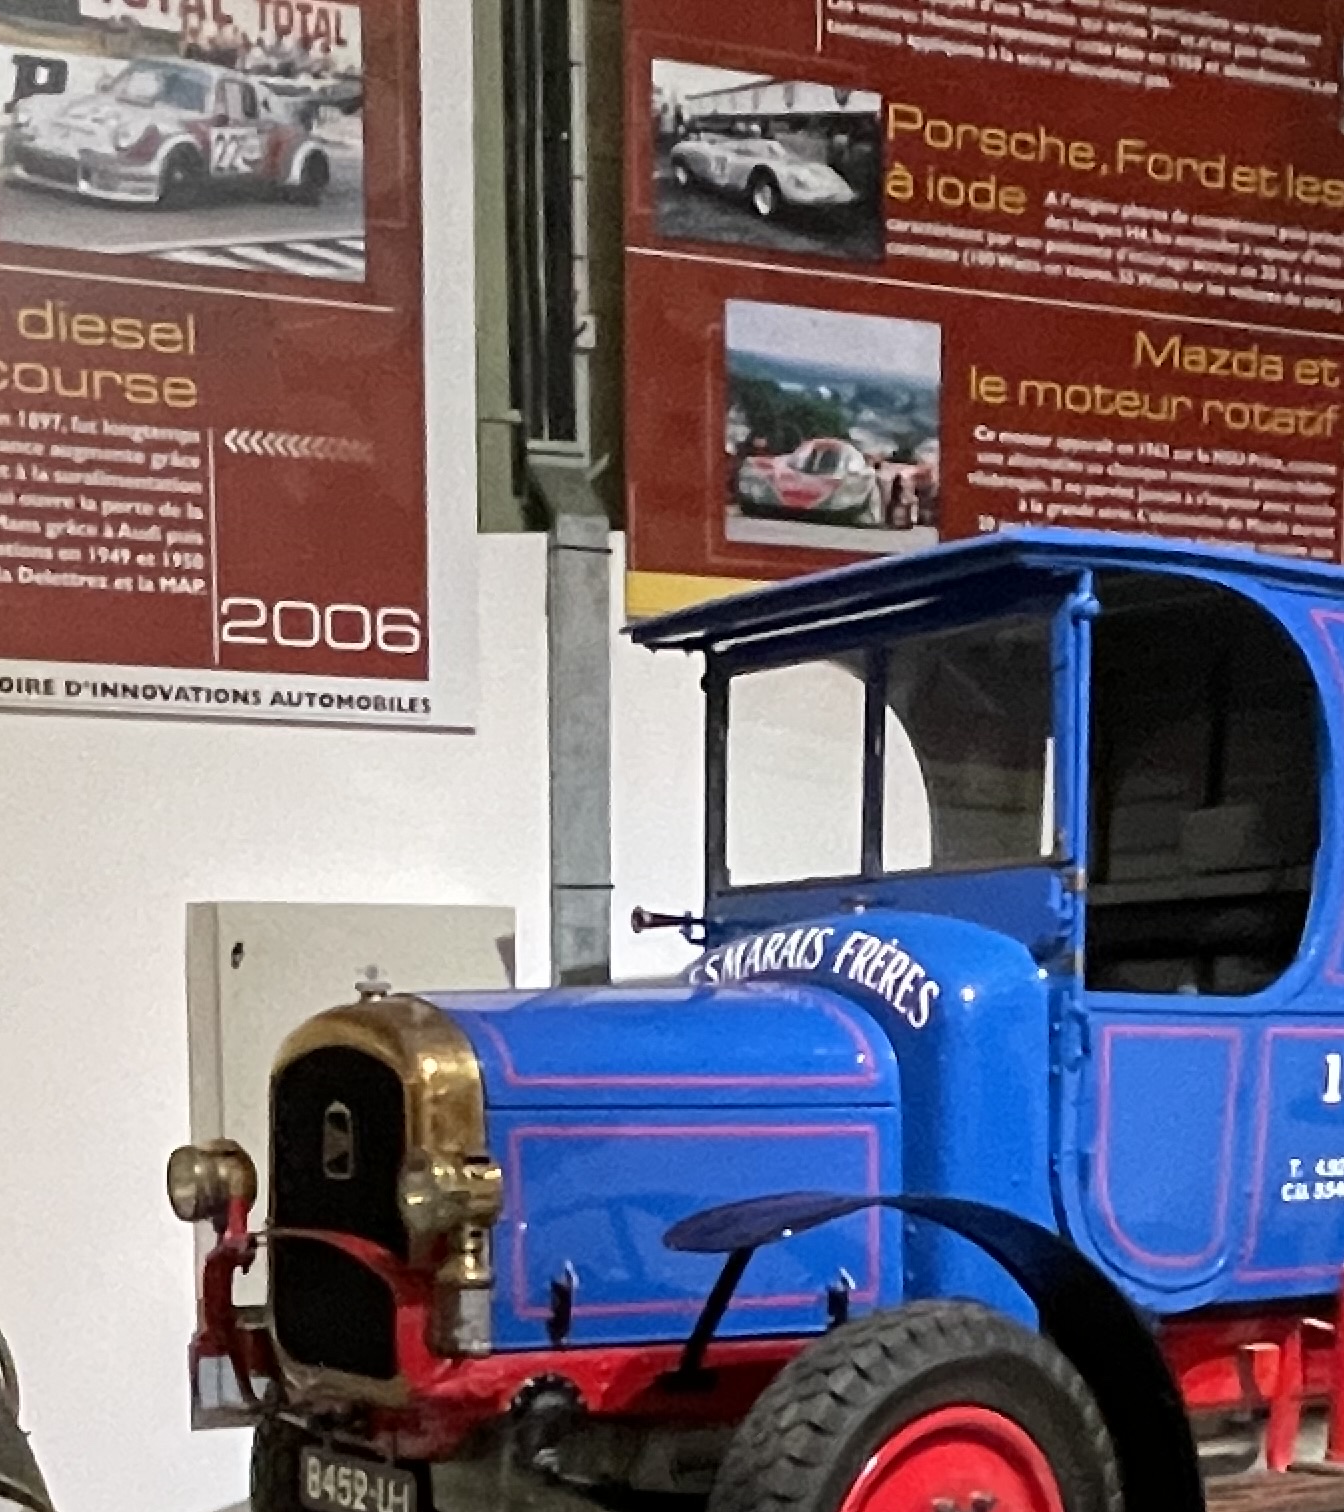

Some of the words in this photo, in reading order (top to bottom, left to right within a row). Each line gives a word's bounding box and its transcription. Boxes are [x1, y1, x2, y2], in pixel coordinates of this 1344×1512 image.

[887, 101, 1109, 177] Porsche,
[1116, 137, 1226, 190] Ford
[1231, 166, 1279, 198] et
[885, 161, 915, 201] à
[926, 164, 1028, 215] iode
[16, 298, 196, 356] diesel
[1132, 329, 1285, 382] Mazda
[1293, 357, 1341, 388] et
[968, 364, 1008, 405] le
[1017, 378, 1193, 422] moteur
[1201, 400, 1340, 437] rotatif
[219, 596, 423, 655] 2006
[64, 679, 263, 707] D'INNOVATIONS
[269, 690, 432, 715] AUTOMOBILES
[1322, 1053, 1342, 1105] 1
